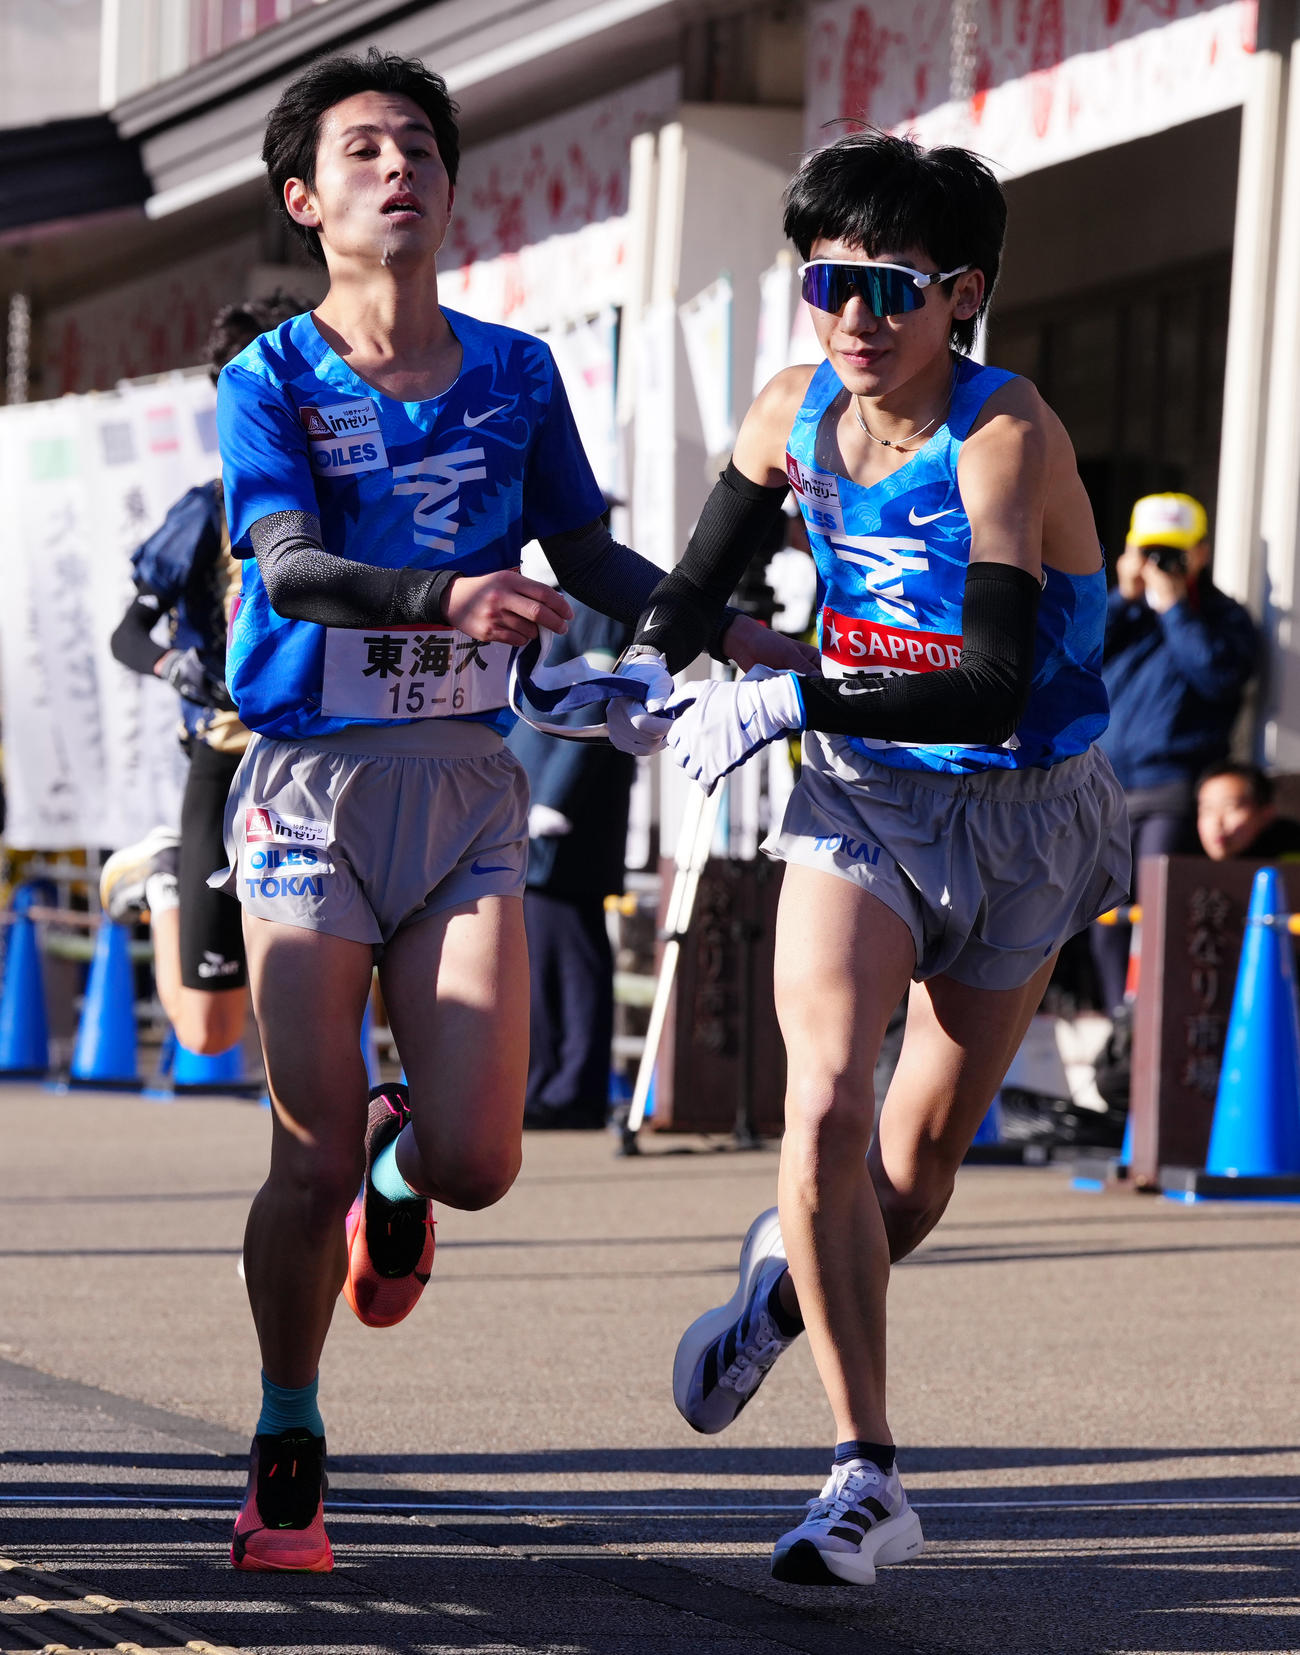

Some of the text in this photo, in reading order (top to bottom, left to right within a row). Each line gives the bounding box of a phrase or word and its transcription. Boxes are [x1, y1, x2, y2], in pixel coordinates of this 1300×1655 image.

[328, 414, 376, 432] inゼリー
[314, 442, 378, 468] OILES
[362, 634, 491, 678] 東海大
[847, 630, 962, 668] SAPPOR
[389, 682, 465, 714] 15-6
[275, 820, 325, 841] inゼリー
[250, 848, 319, 870] OILES
[814, 832, 881, 866] TOKAI
[245, 876, 324, 898] TOKAI
